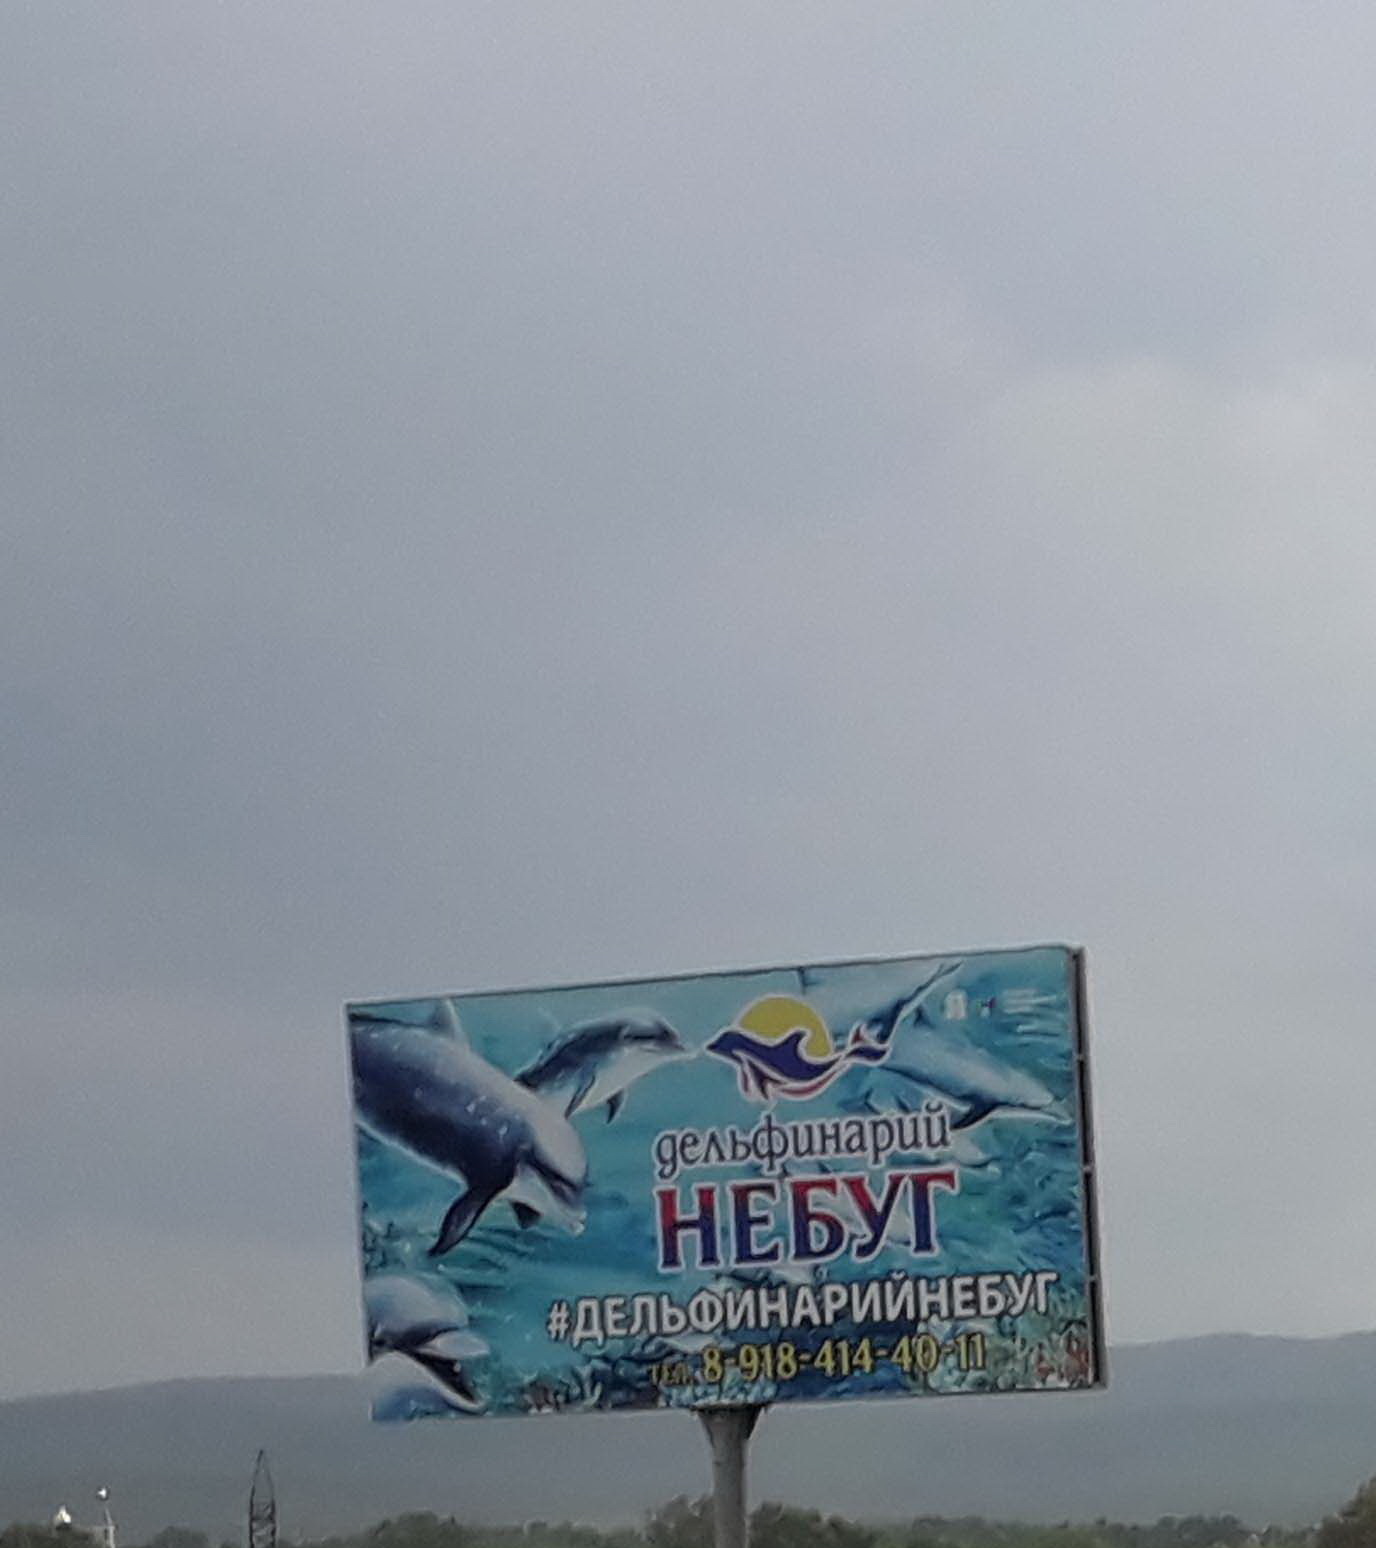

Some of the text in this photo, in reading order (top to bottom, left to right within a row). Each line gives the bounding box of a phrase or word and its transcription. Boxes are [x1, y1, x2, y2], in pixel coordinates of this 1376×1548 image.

[656, 1103, 950, 1179] дельфинарий
[656, 1170, 956, 1269] НЕБУГ
[548, 1271, 1058, 1346] #ДЕЛЬФИНАРИЙНЕБУГ
[702, 1332, 987, 1382] 8-918-414-40-11
